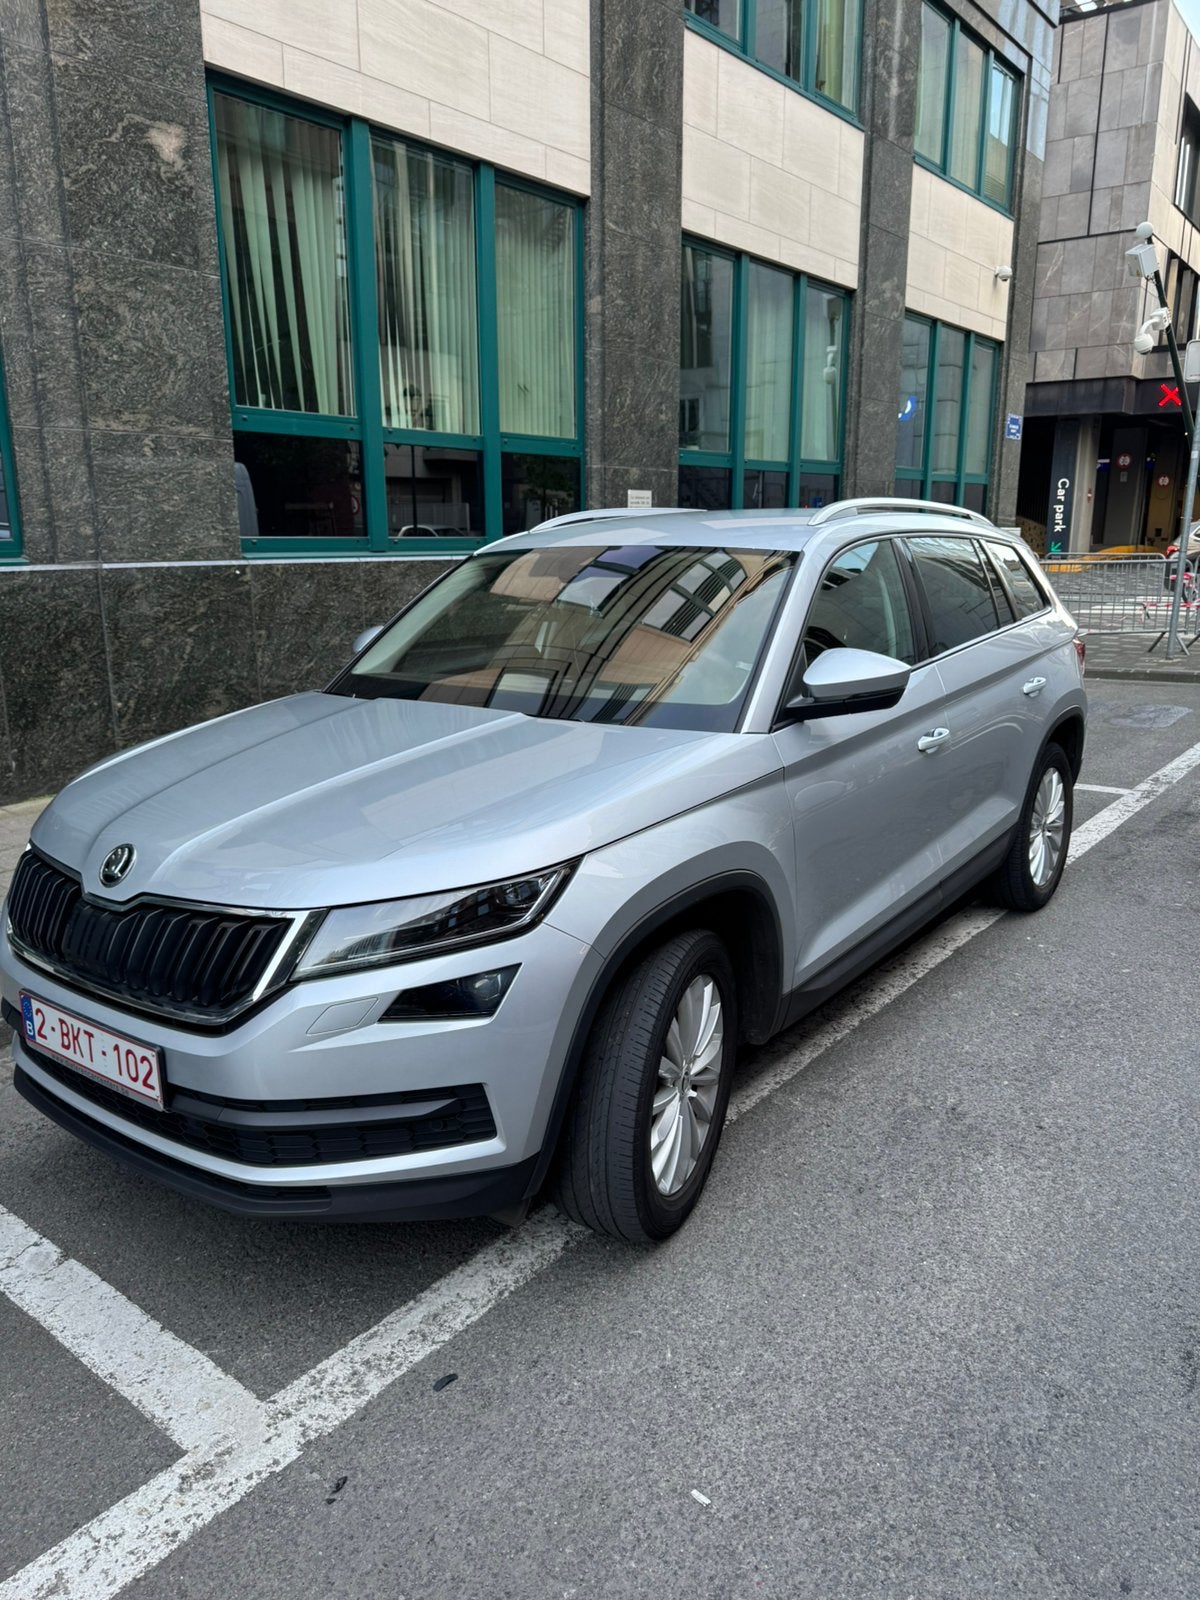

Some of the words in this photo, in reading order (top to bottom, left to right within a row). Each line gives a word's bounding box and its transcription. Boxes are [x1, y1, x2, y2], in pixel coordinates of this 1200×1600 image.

[1057, 478, 1070, 502] Car
[1053, 504, 1067, 532] park
[26, 1020, 34, 1036] B
